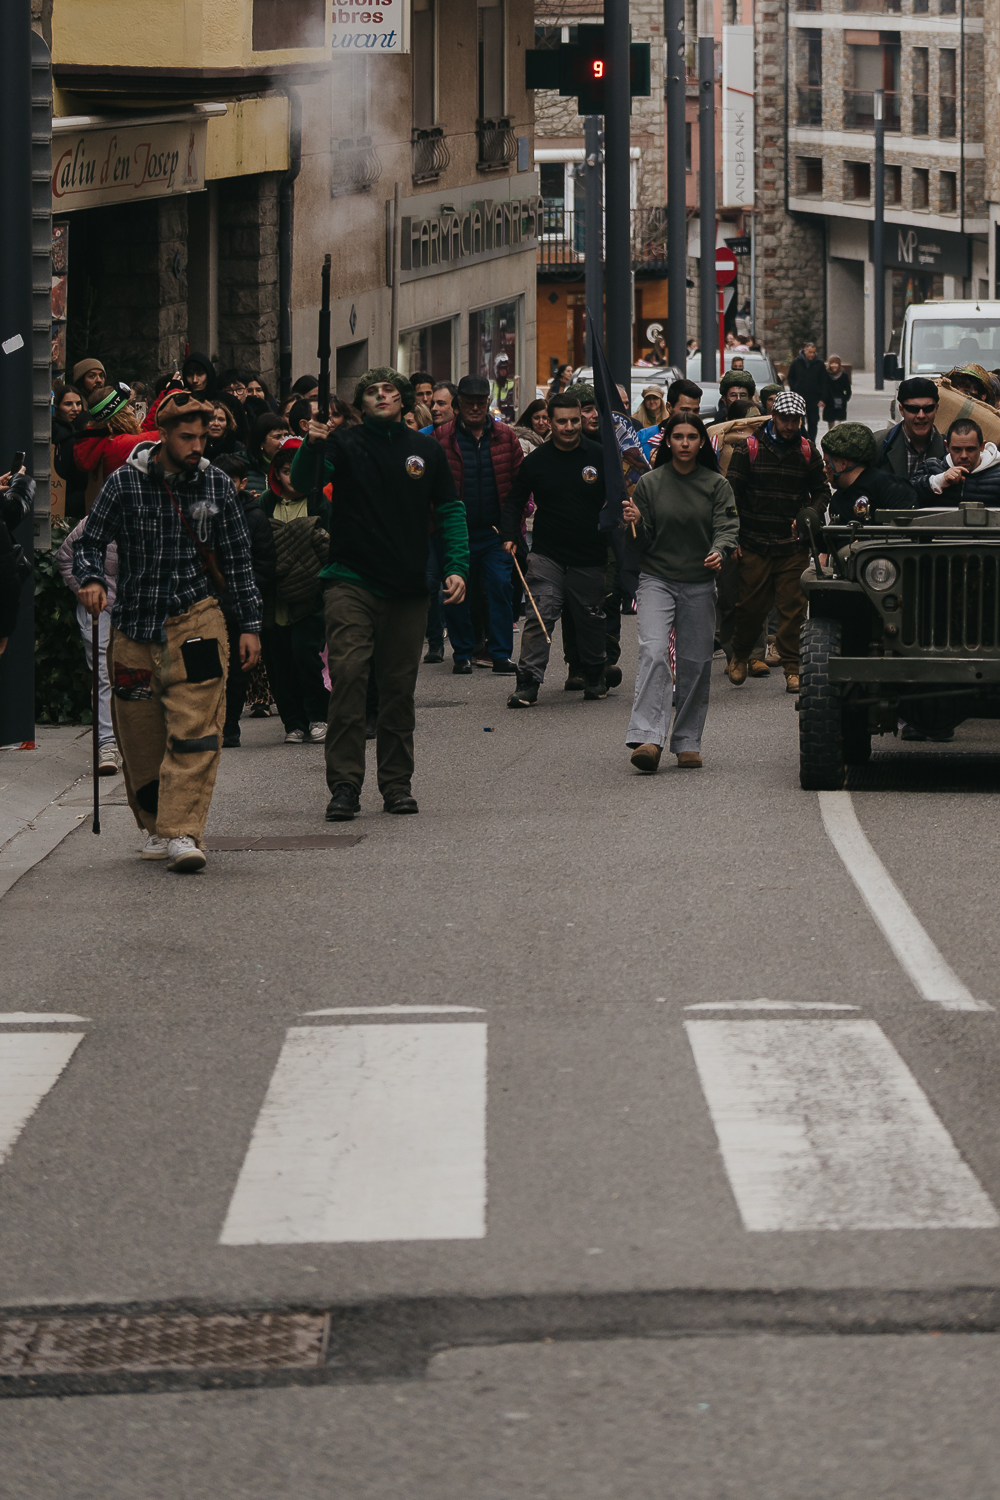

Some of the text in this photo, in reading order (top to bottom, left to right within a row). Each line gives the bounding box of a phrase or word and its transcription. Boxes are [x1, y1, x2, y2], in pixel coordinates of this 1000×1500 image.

[593, 60, 604, 78] 9
[52, 138, 97, 198] Caliu
[133, 142, 179, 190] Josep
[735, 112, 745, 203] ANDBANK
[475, 195, 544, 251] MANRESA
